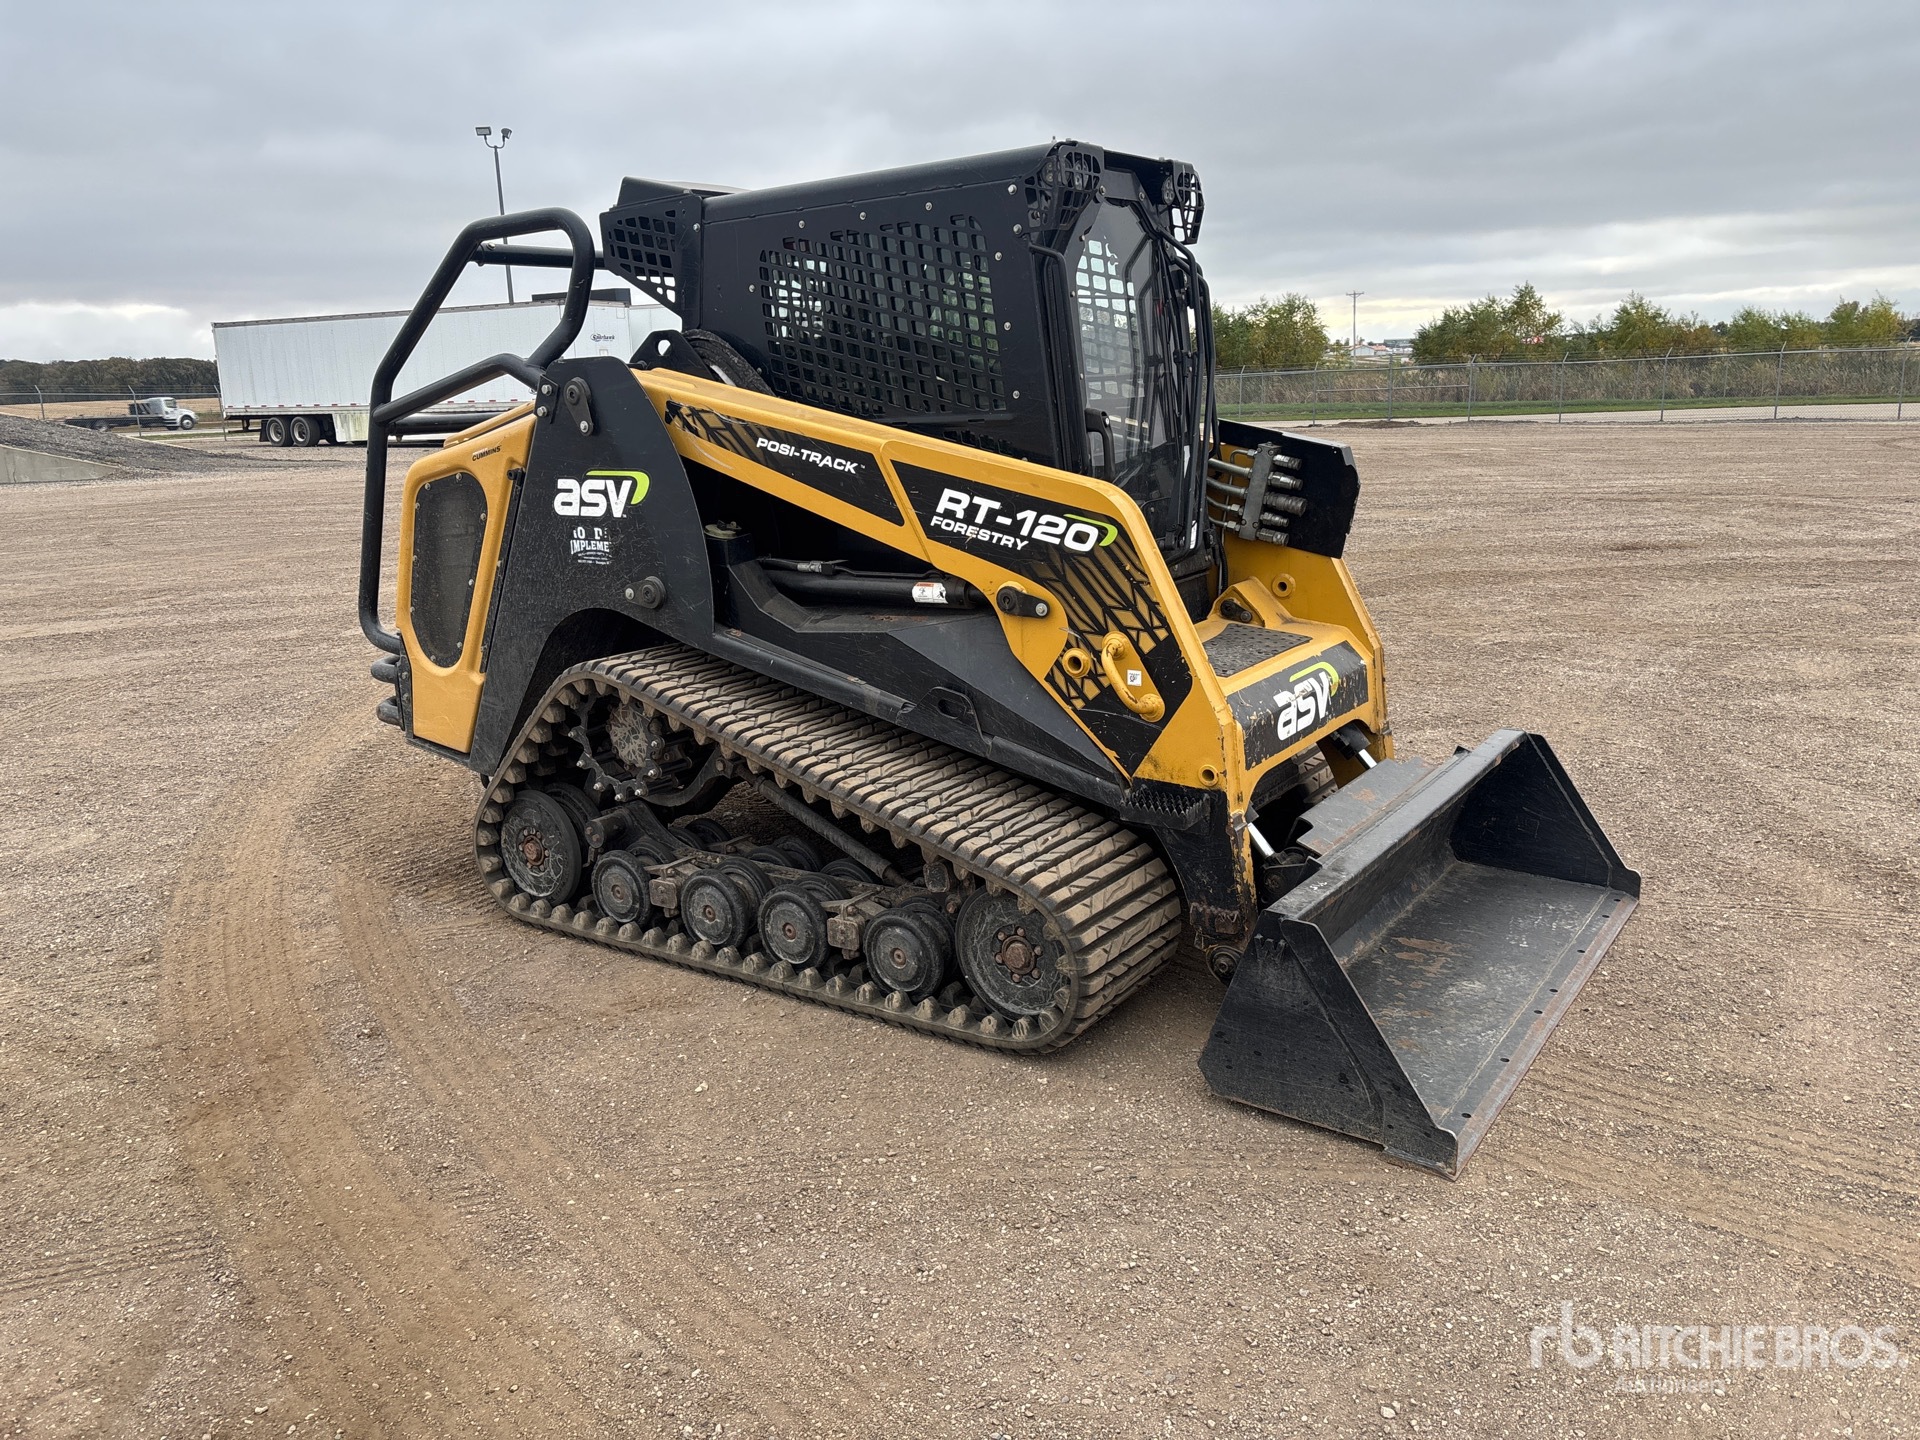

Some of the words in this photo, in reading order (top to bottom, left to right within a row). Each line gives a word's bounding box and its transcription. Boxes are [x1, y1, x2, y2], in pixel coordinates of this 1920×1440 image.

[472, 445, 502, 461] CUMMINS
[756, 437, 859, 474] POSI-TRACK
[930, 515, 1029, 551] FORESTRY
[935, 488, 1099, 552] RT-120
[570, 539, 612, 555] IMPLEME
